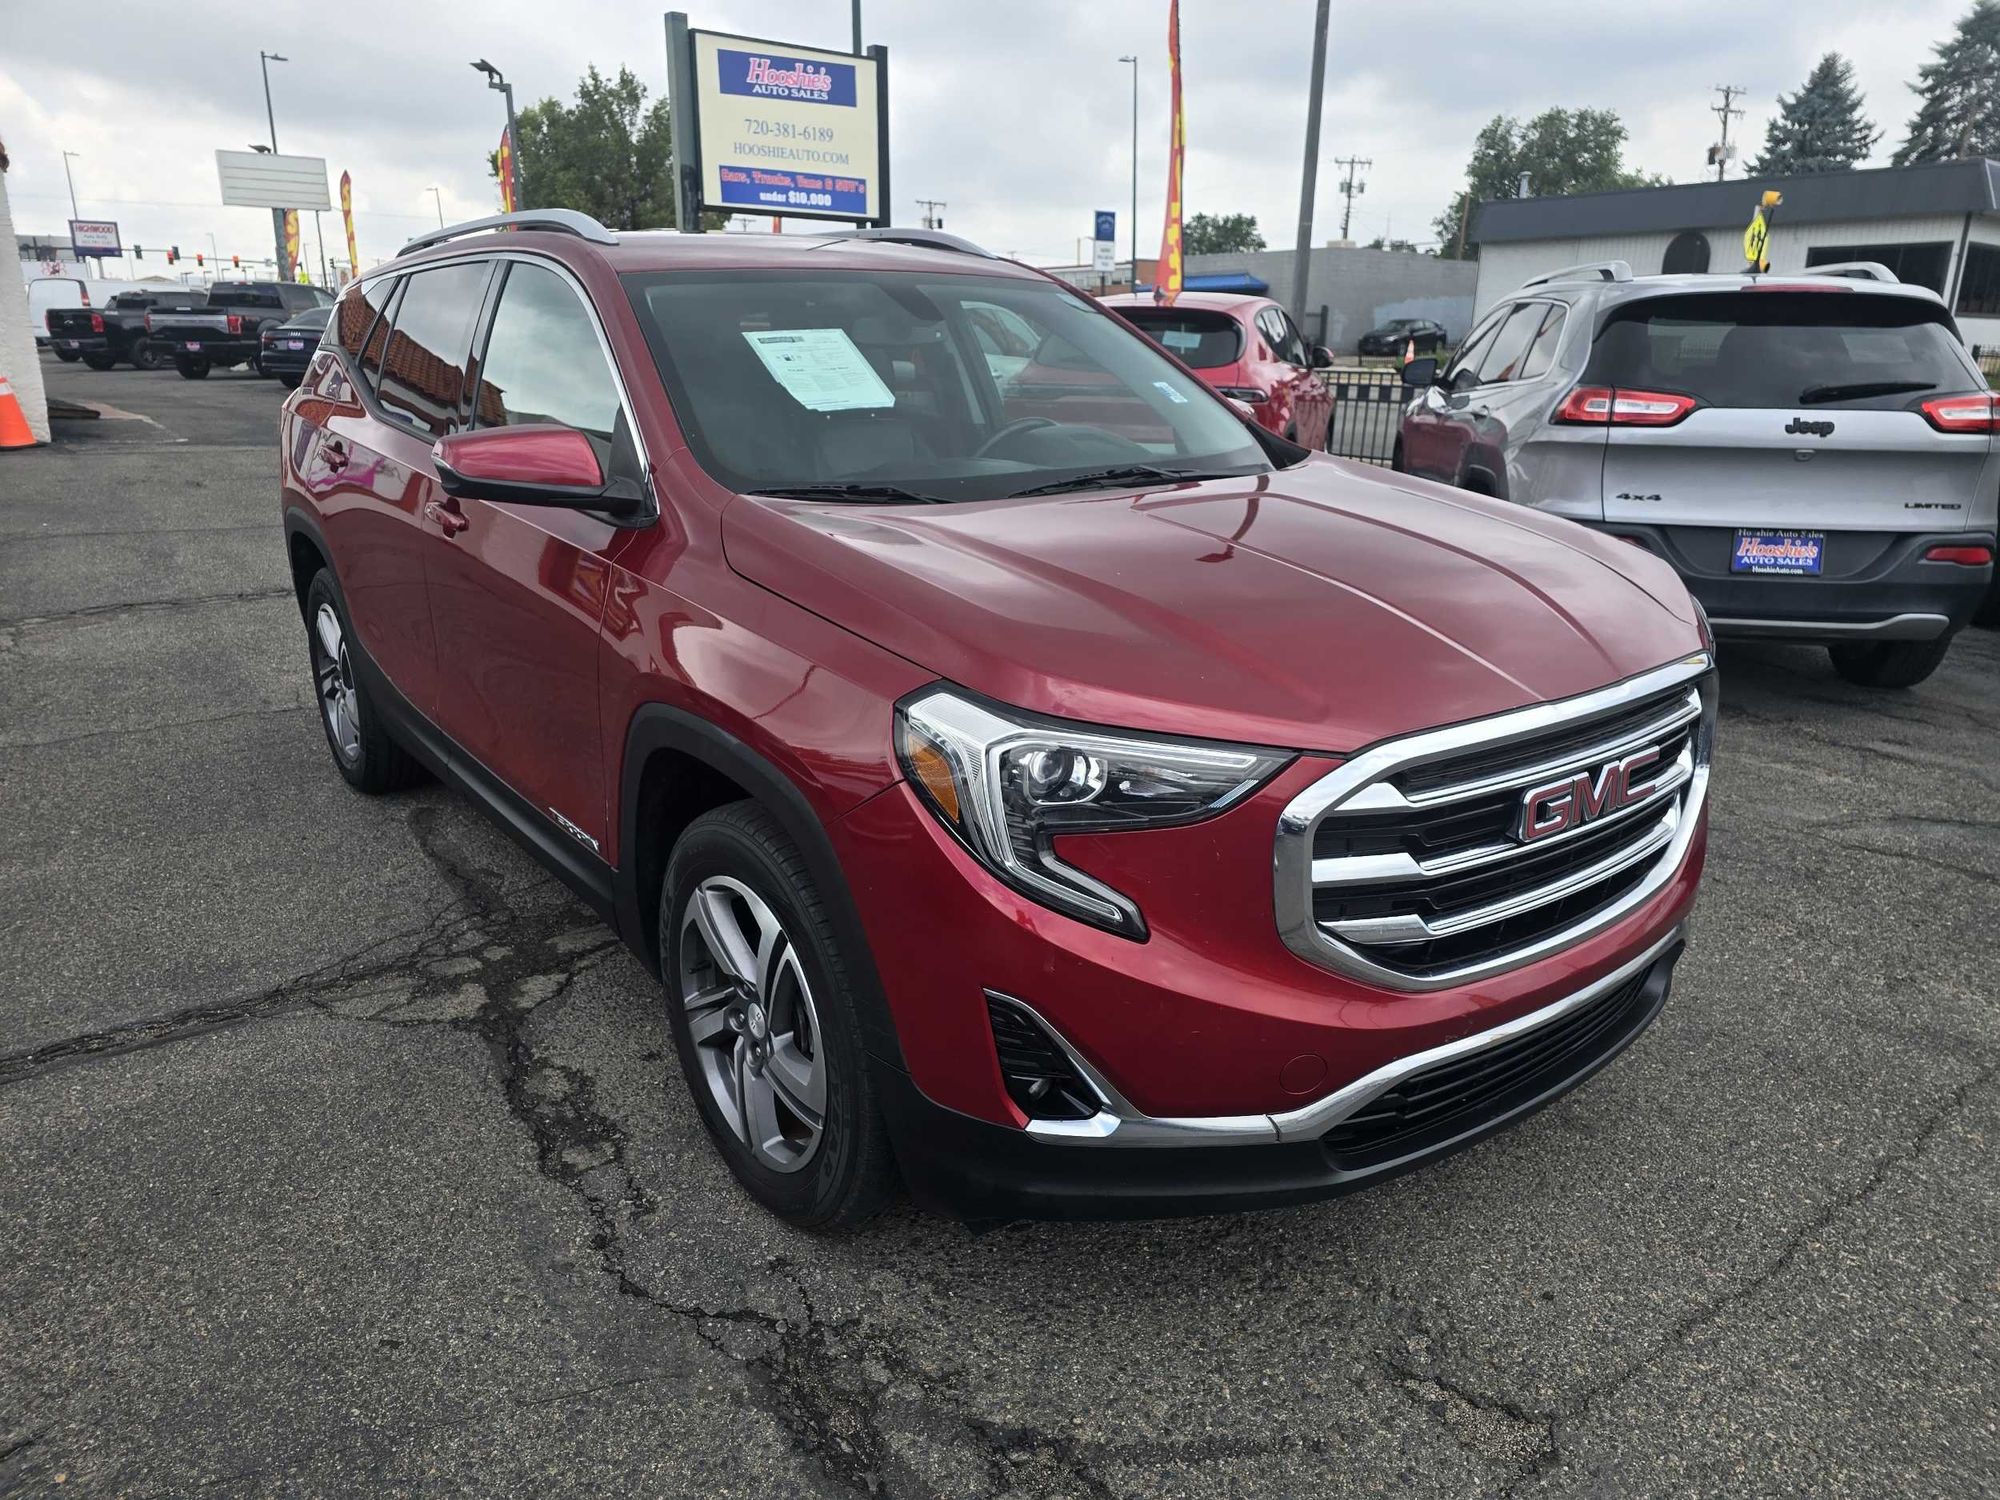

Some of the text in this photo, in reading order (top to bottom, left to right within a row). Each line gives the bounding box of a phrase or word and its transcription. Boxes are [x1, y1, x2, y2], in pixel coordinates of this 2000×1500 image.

[746, 57, 831, 91] Hooshie's
[752, 84, 829, 100] AUTO SALES
[744, 119, 834, 141] 720-381-6189
[733, 142, 849, 165] HOOSHIEAUTO.COM
[787, 190, 832, 207] $10,000
[1784, 416, 1835, 438] Jeep
[1904, 502, 1962, 510] LIMITED
[1736, 537, 1818, 558] Hooshie's
[1741, 556, 1813, 566] AUTO SALES
[1518, 745, 1660, 843] GMC
